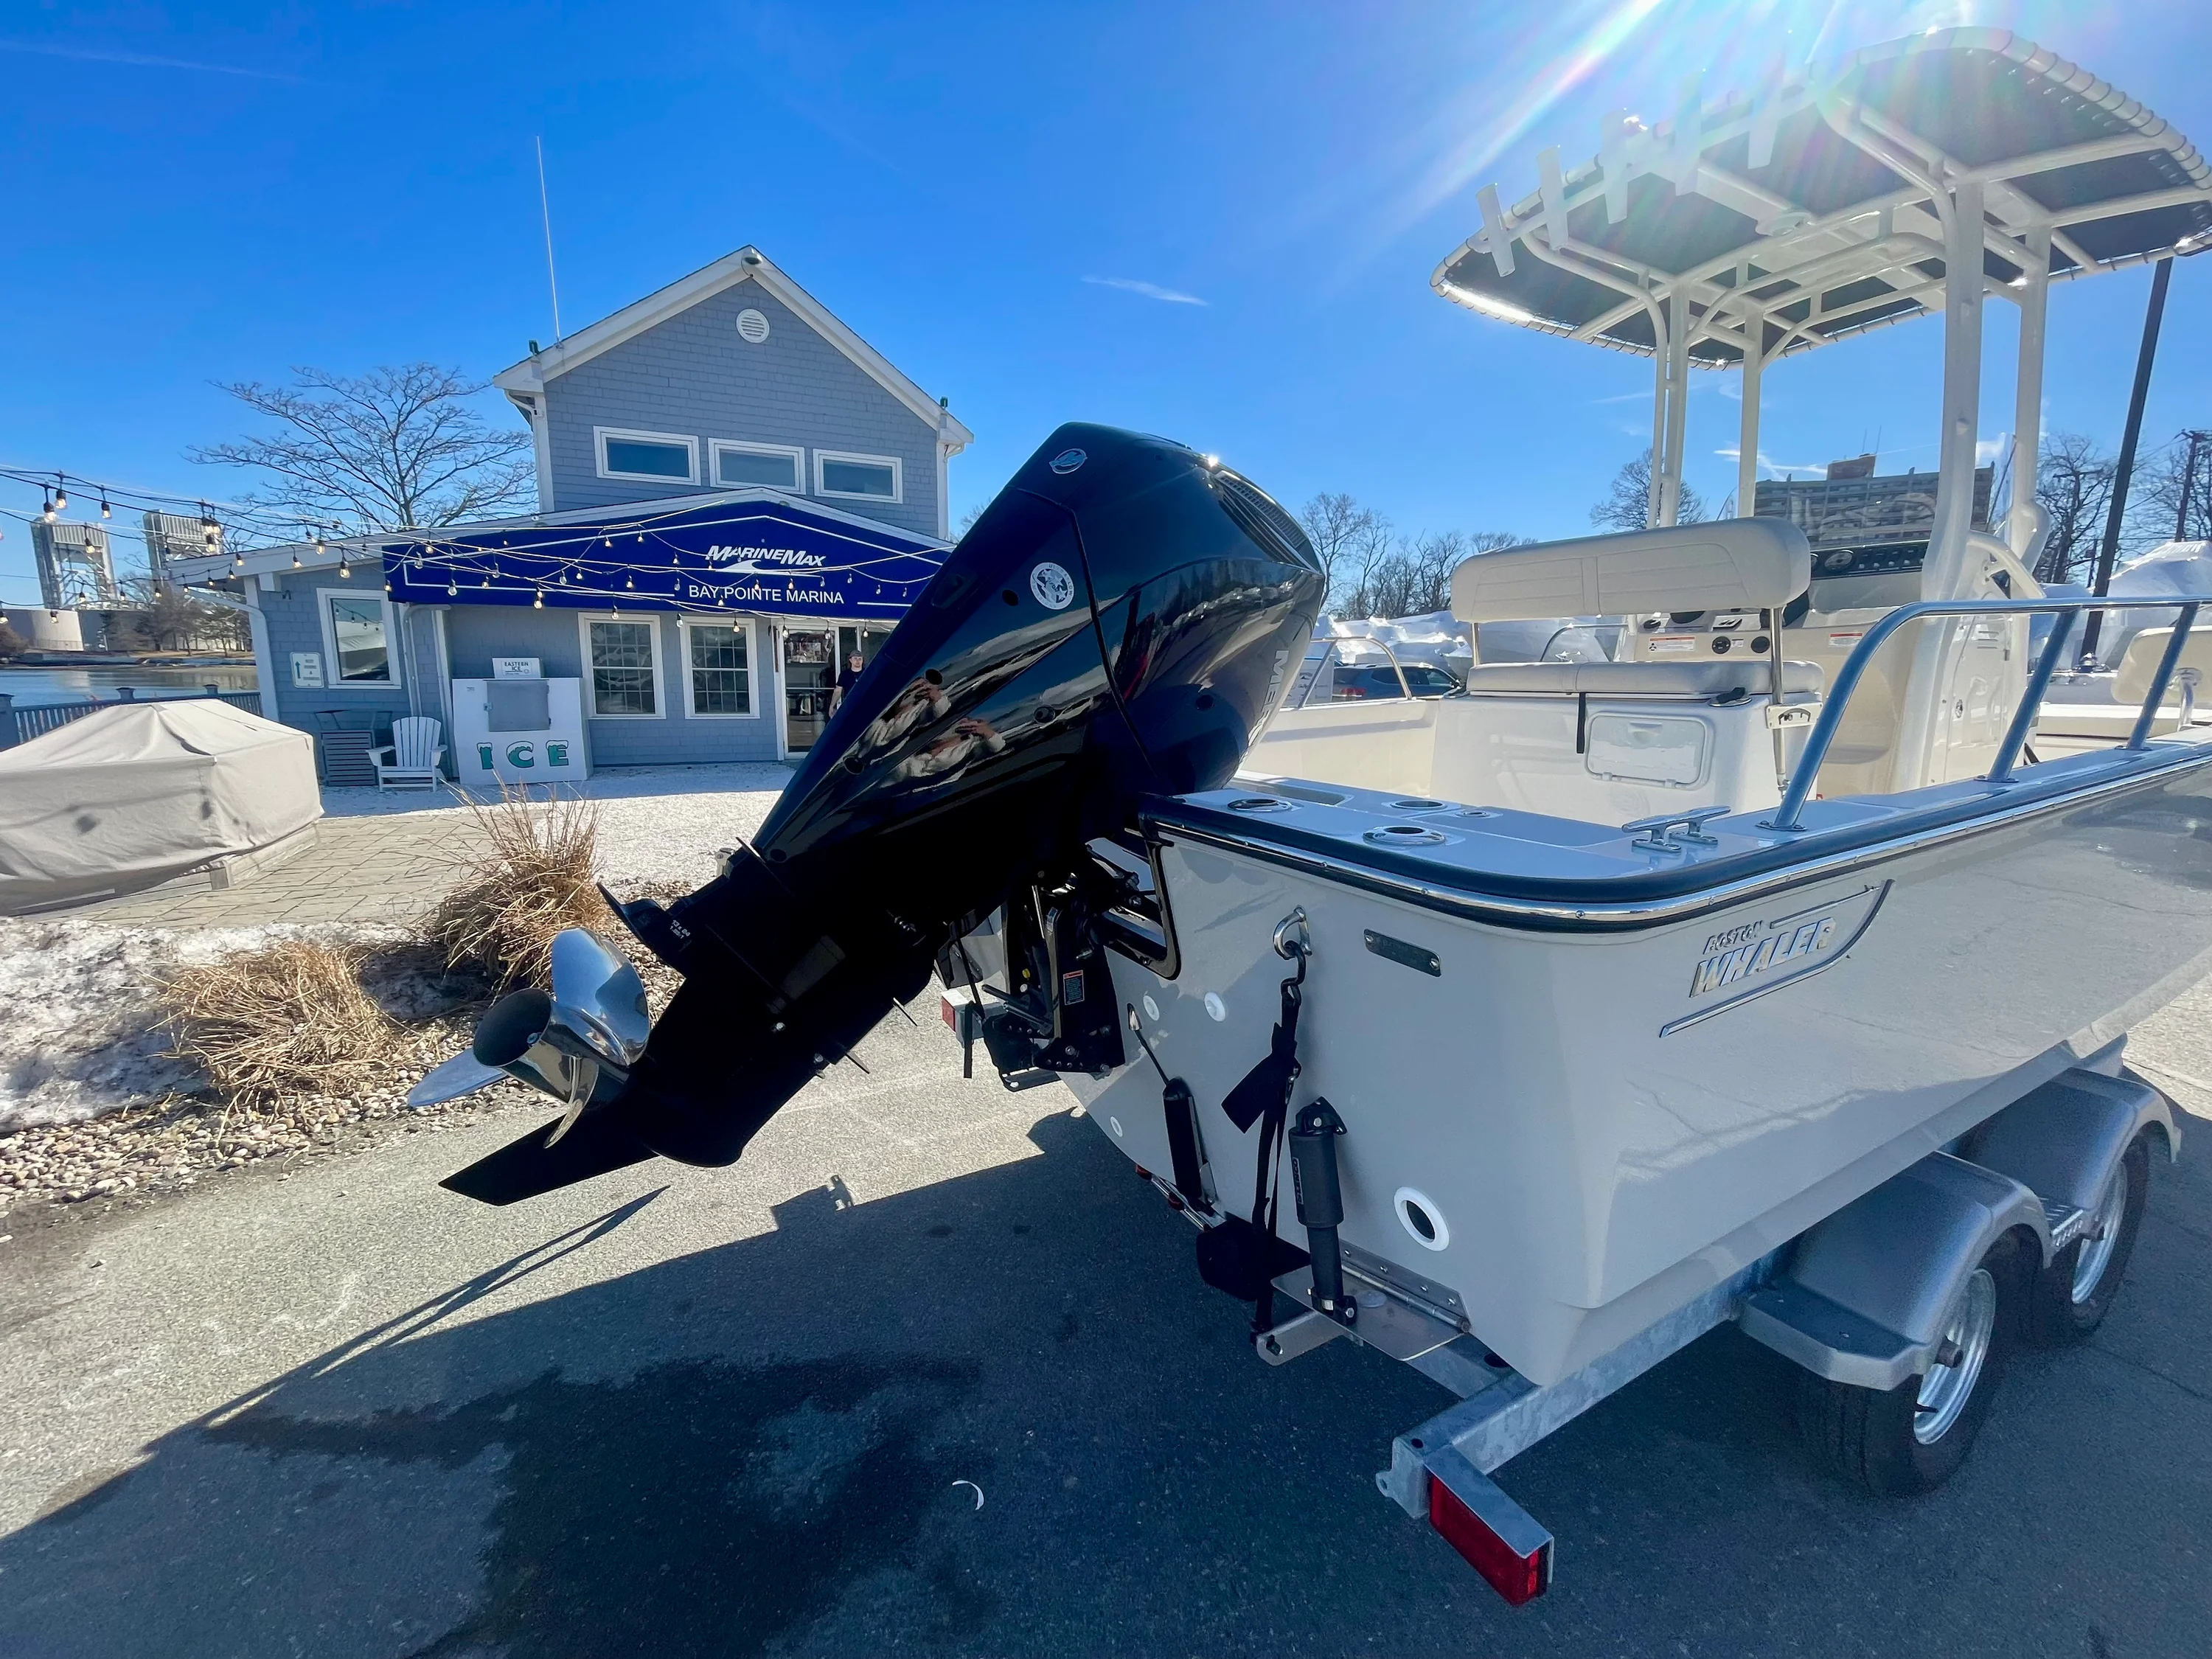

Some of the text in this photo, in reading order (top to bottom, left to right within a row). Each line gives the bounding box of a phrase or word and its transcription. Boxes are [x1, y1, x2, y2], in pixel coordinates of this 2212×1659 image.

[705, 545, 827, 567] MARINEMAX
[689, 585, 845, 604] BAY POINTE MARINA
[476, 740, 569, 771] ICE
[1703, 919, 1764, 956] BOSTON
[1689, 917, 1837, 998] WHALER
